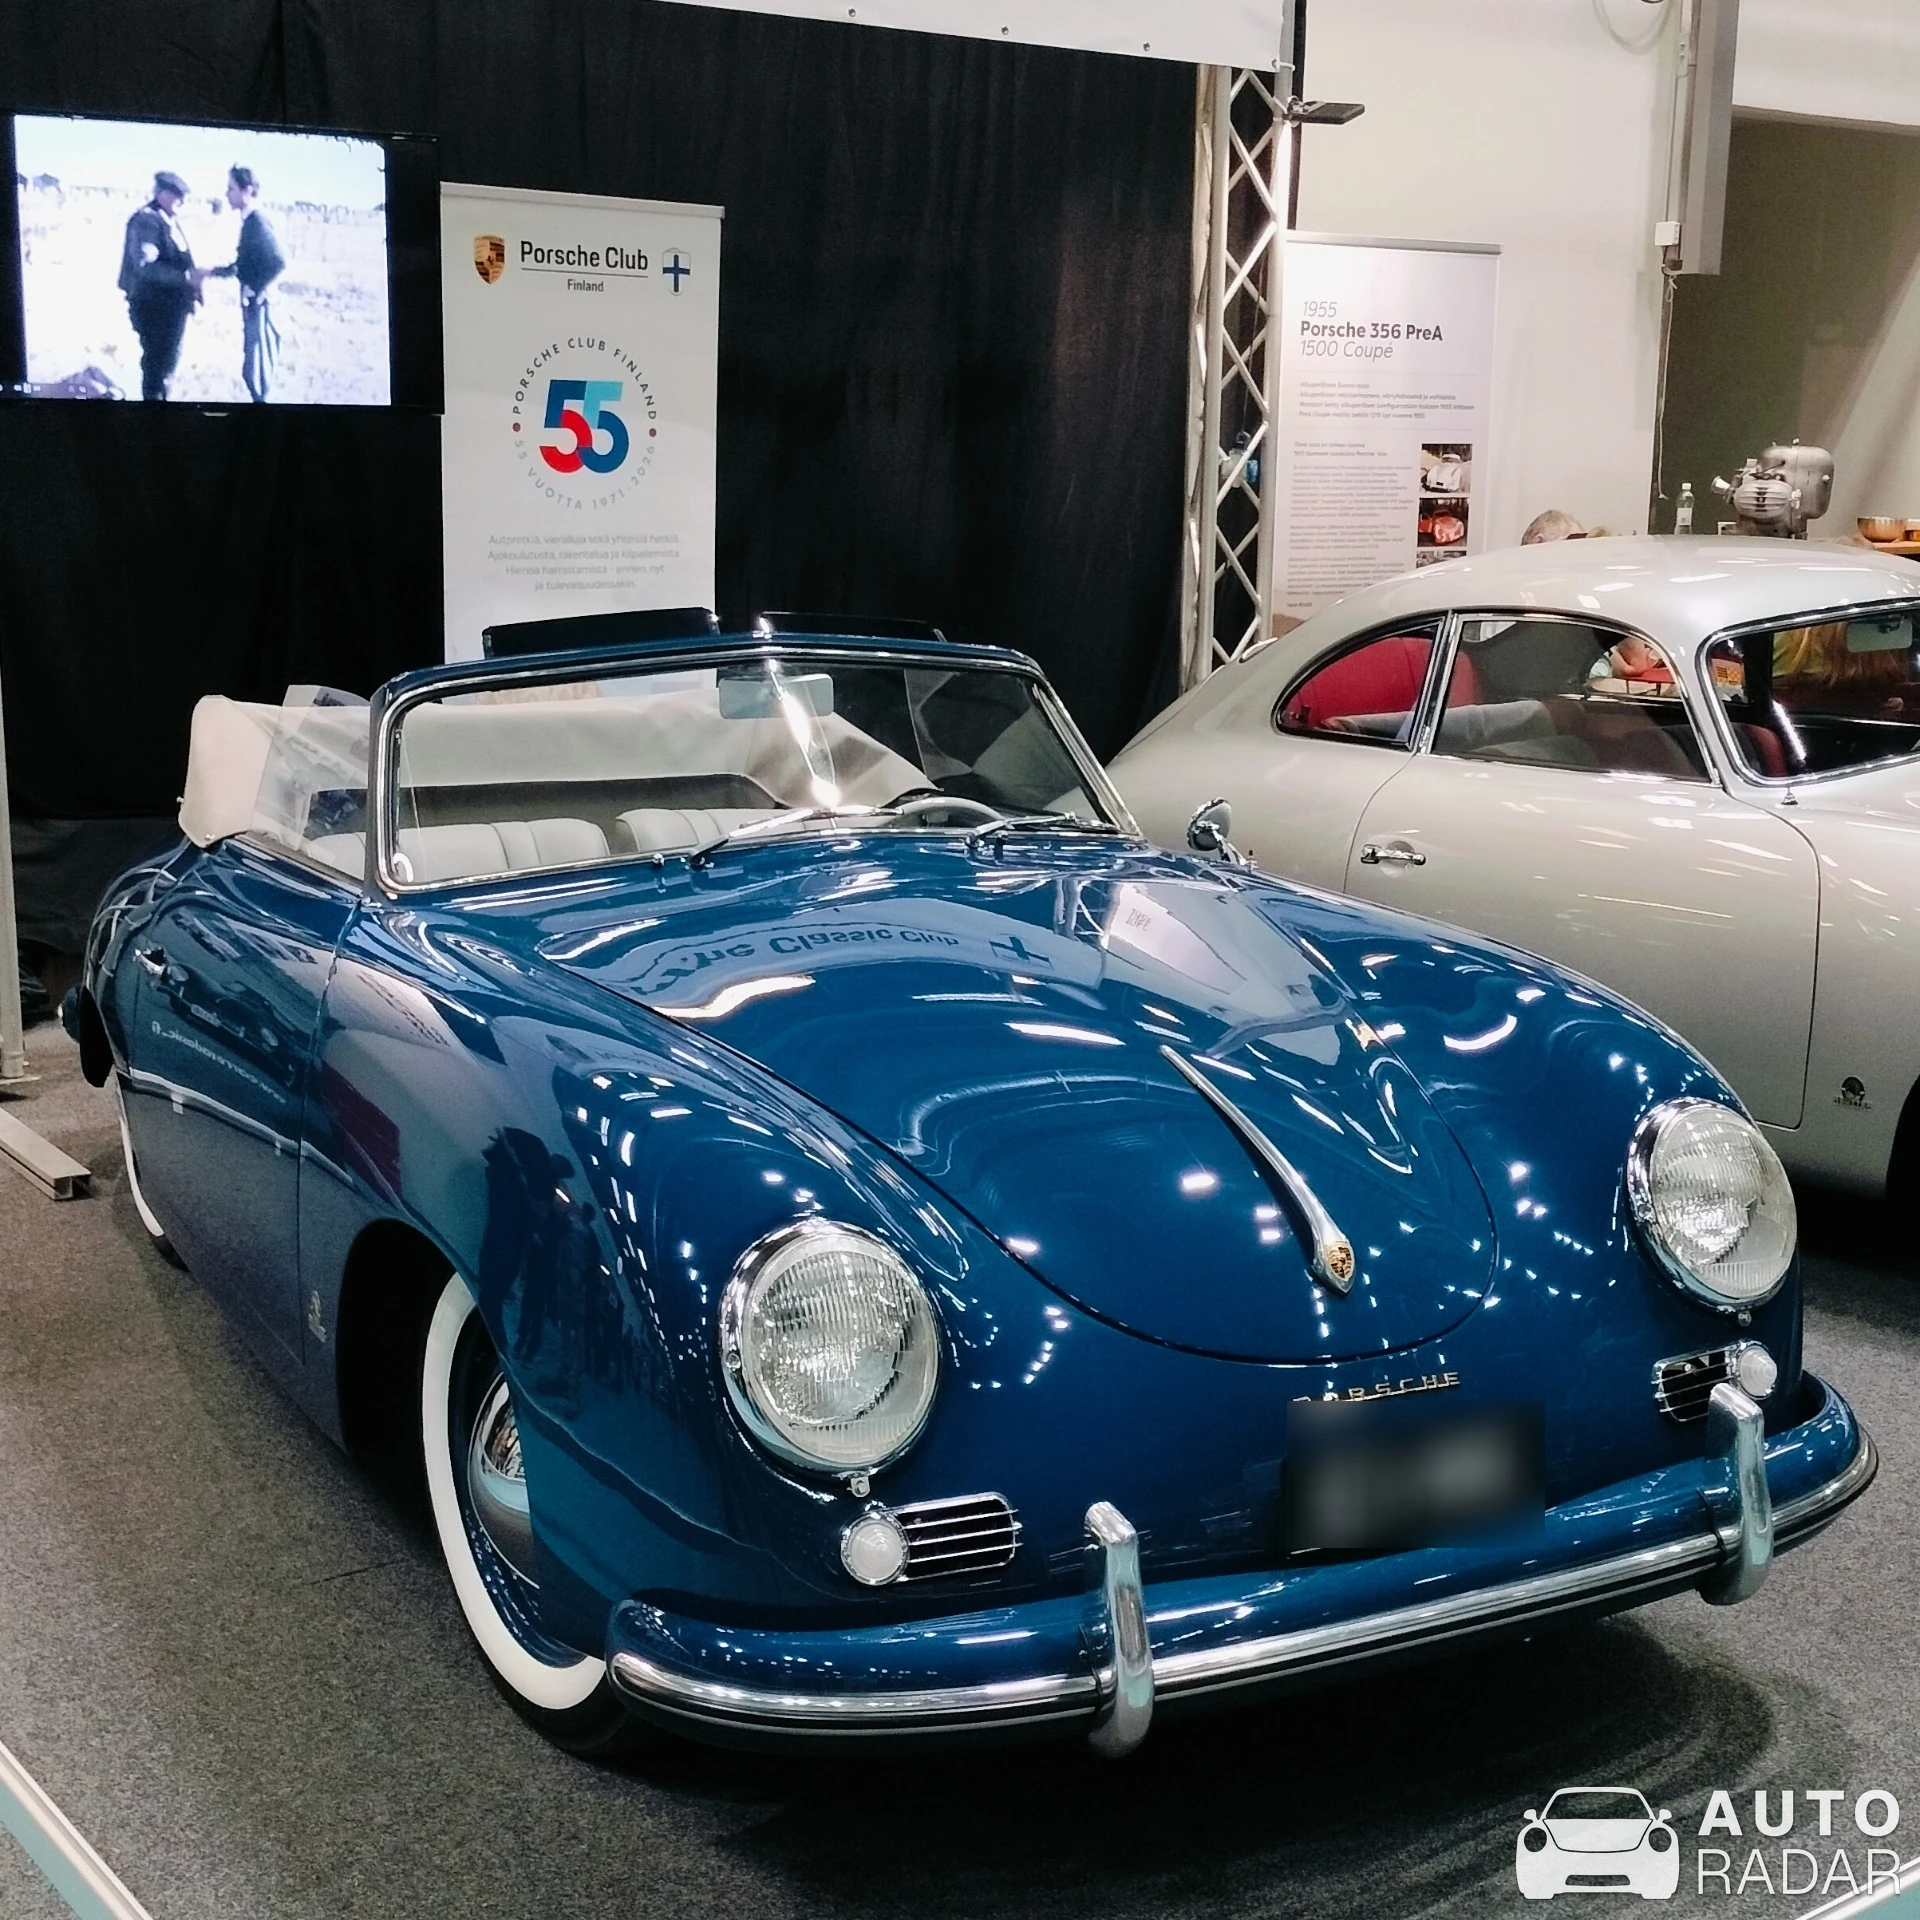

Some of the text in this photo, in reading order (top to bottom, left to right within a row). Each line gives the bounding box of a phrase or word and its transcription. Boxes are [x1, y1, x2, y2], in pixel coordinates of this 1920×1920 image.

[520, 240, 648, 271] Porsche Club
[567, 279, 604, 292] Finland
[1303, 301, 1338, 318] 1955
[1300, 320, 1443, 341] Porsche 356 PreA
[1300, 340, 1394, 362] 1500 Coupé
[512, 337, 657, 420] PORSCHE CLUB FINLAND
[539, 379, 630, 474] 55
[527, 467, 583, 510] VUOTTA
